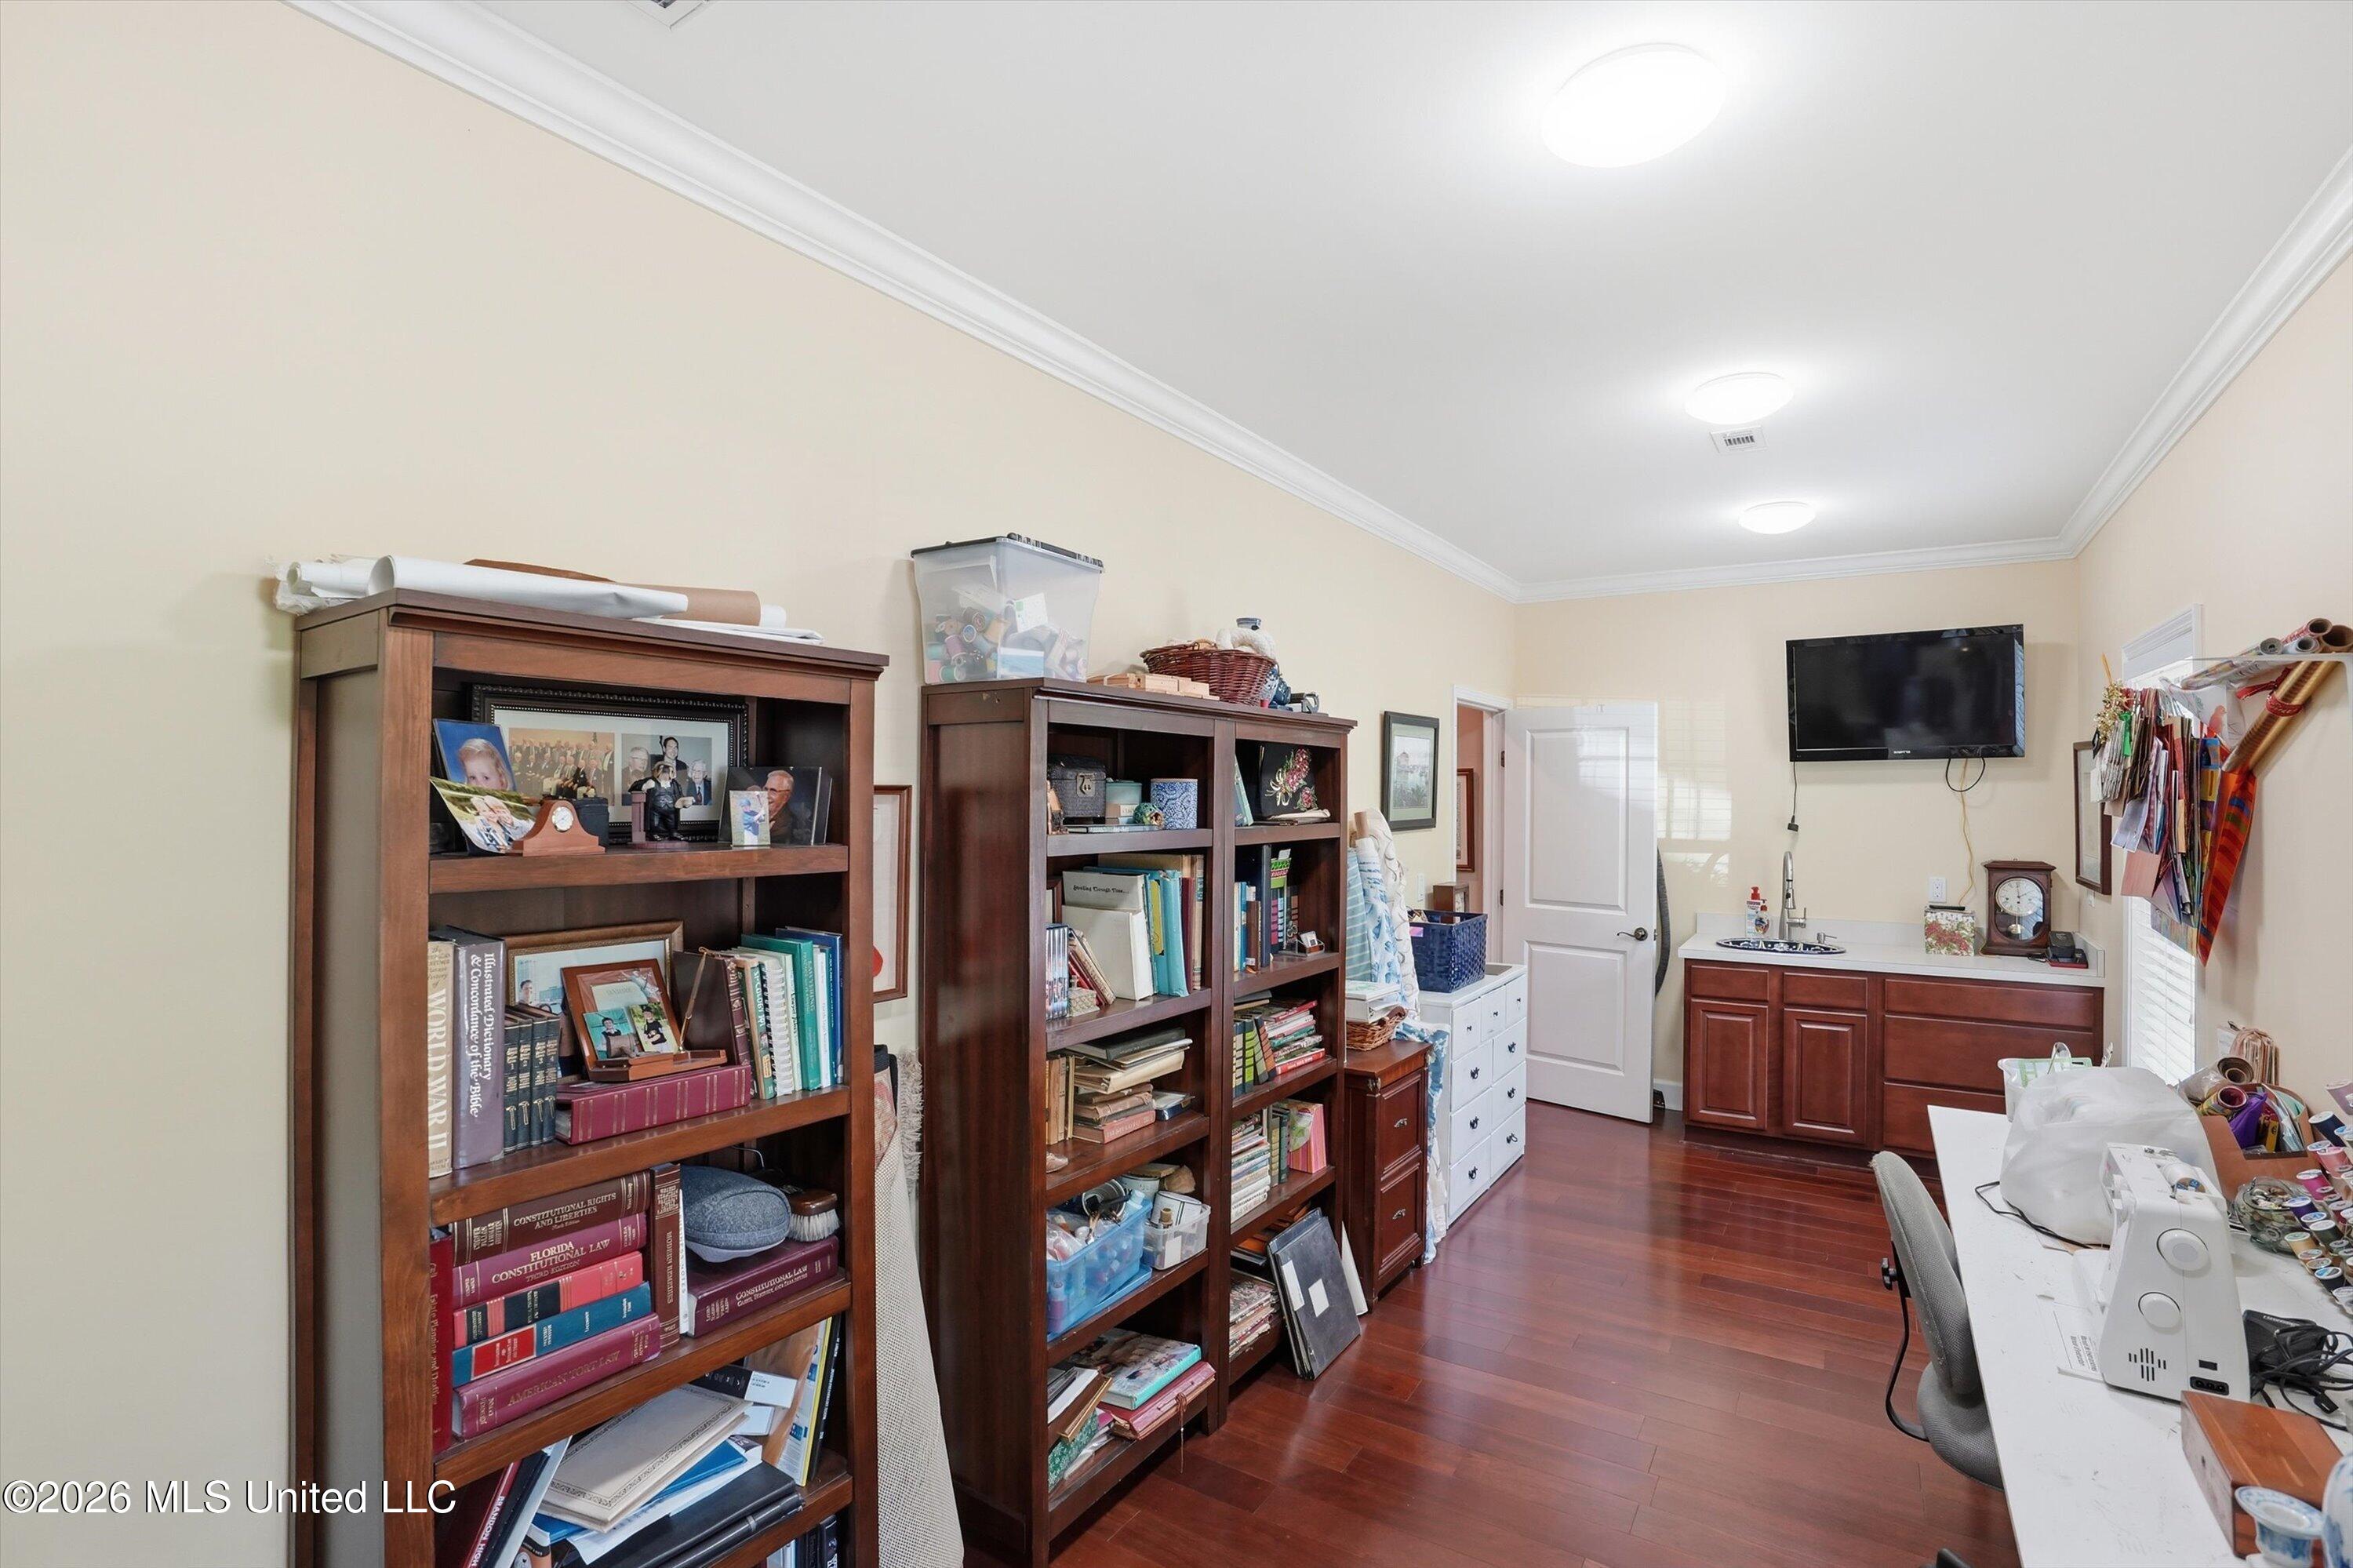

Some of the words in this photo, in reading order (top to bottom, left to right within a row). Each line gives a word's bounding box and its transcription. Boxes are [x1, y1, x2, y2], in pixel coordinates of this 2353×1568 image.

[471, 954, 482, 967] &
[483, 952, 496, 1013] Illustrated
[470, 968, 482, 1043] Concordance
[427, 988, 447, 1073] WORLD
[479, 1013, 495, 1080] Dictionary
[466, 1045, 482, 1059] of
[470, 1060, 482, 1082] the
[427, 1075, 448, 1125] WAR
[469, 1082, 482, 1118] Bible
[428, 1132, 448, 1149] II
[514, 1200, 587, 1228] CONSTITUTIONAL
[587, 1191, 617, 1208] RIGHTS
[534, 1217, 553, 1231] AND
[554, 1206, 598, 1225] LIBERTIES
[491, 1248, 587, 1284] CONSTITUTIONAL
[588, 1239, 610, 1255] LAW
[530, 1241, 575, 1264] FLORIDA
[735, 1273, 793, 1301] CONSTITUTIONAL
[793, 1264, 809, 1280] LAW
[480, 1495, 505, 1541] BRANDON
[471, 1543, 486, 1567] HIGH
